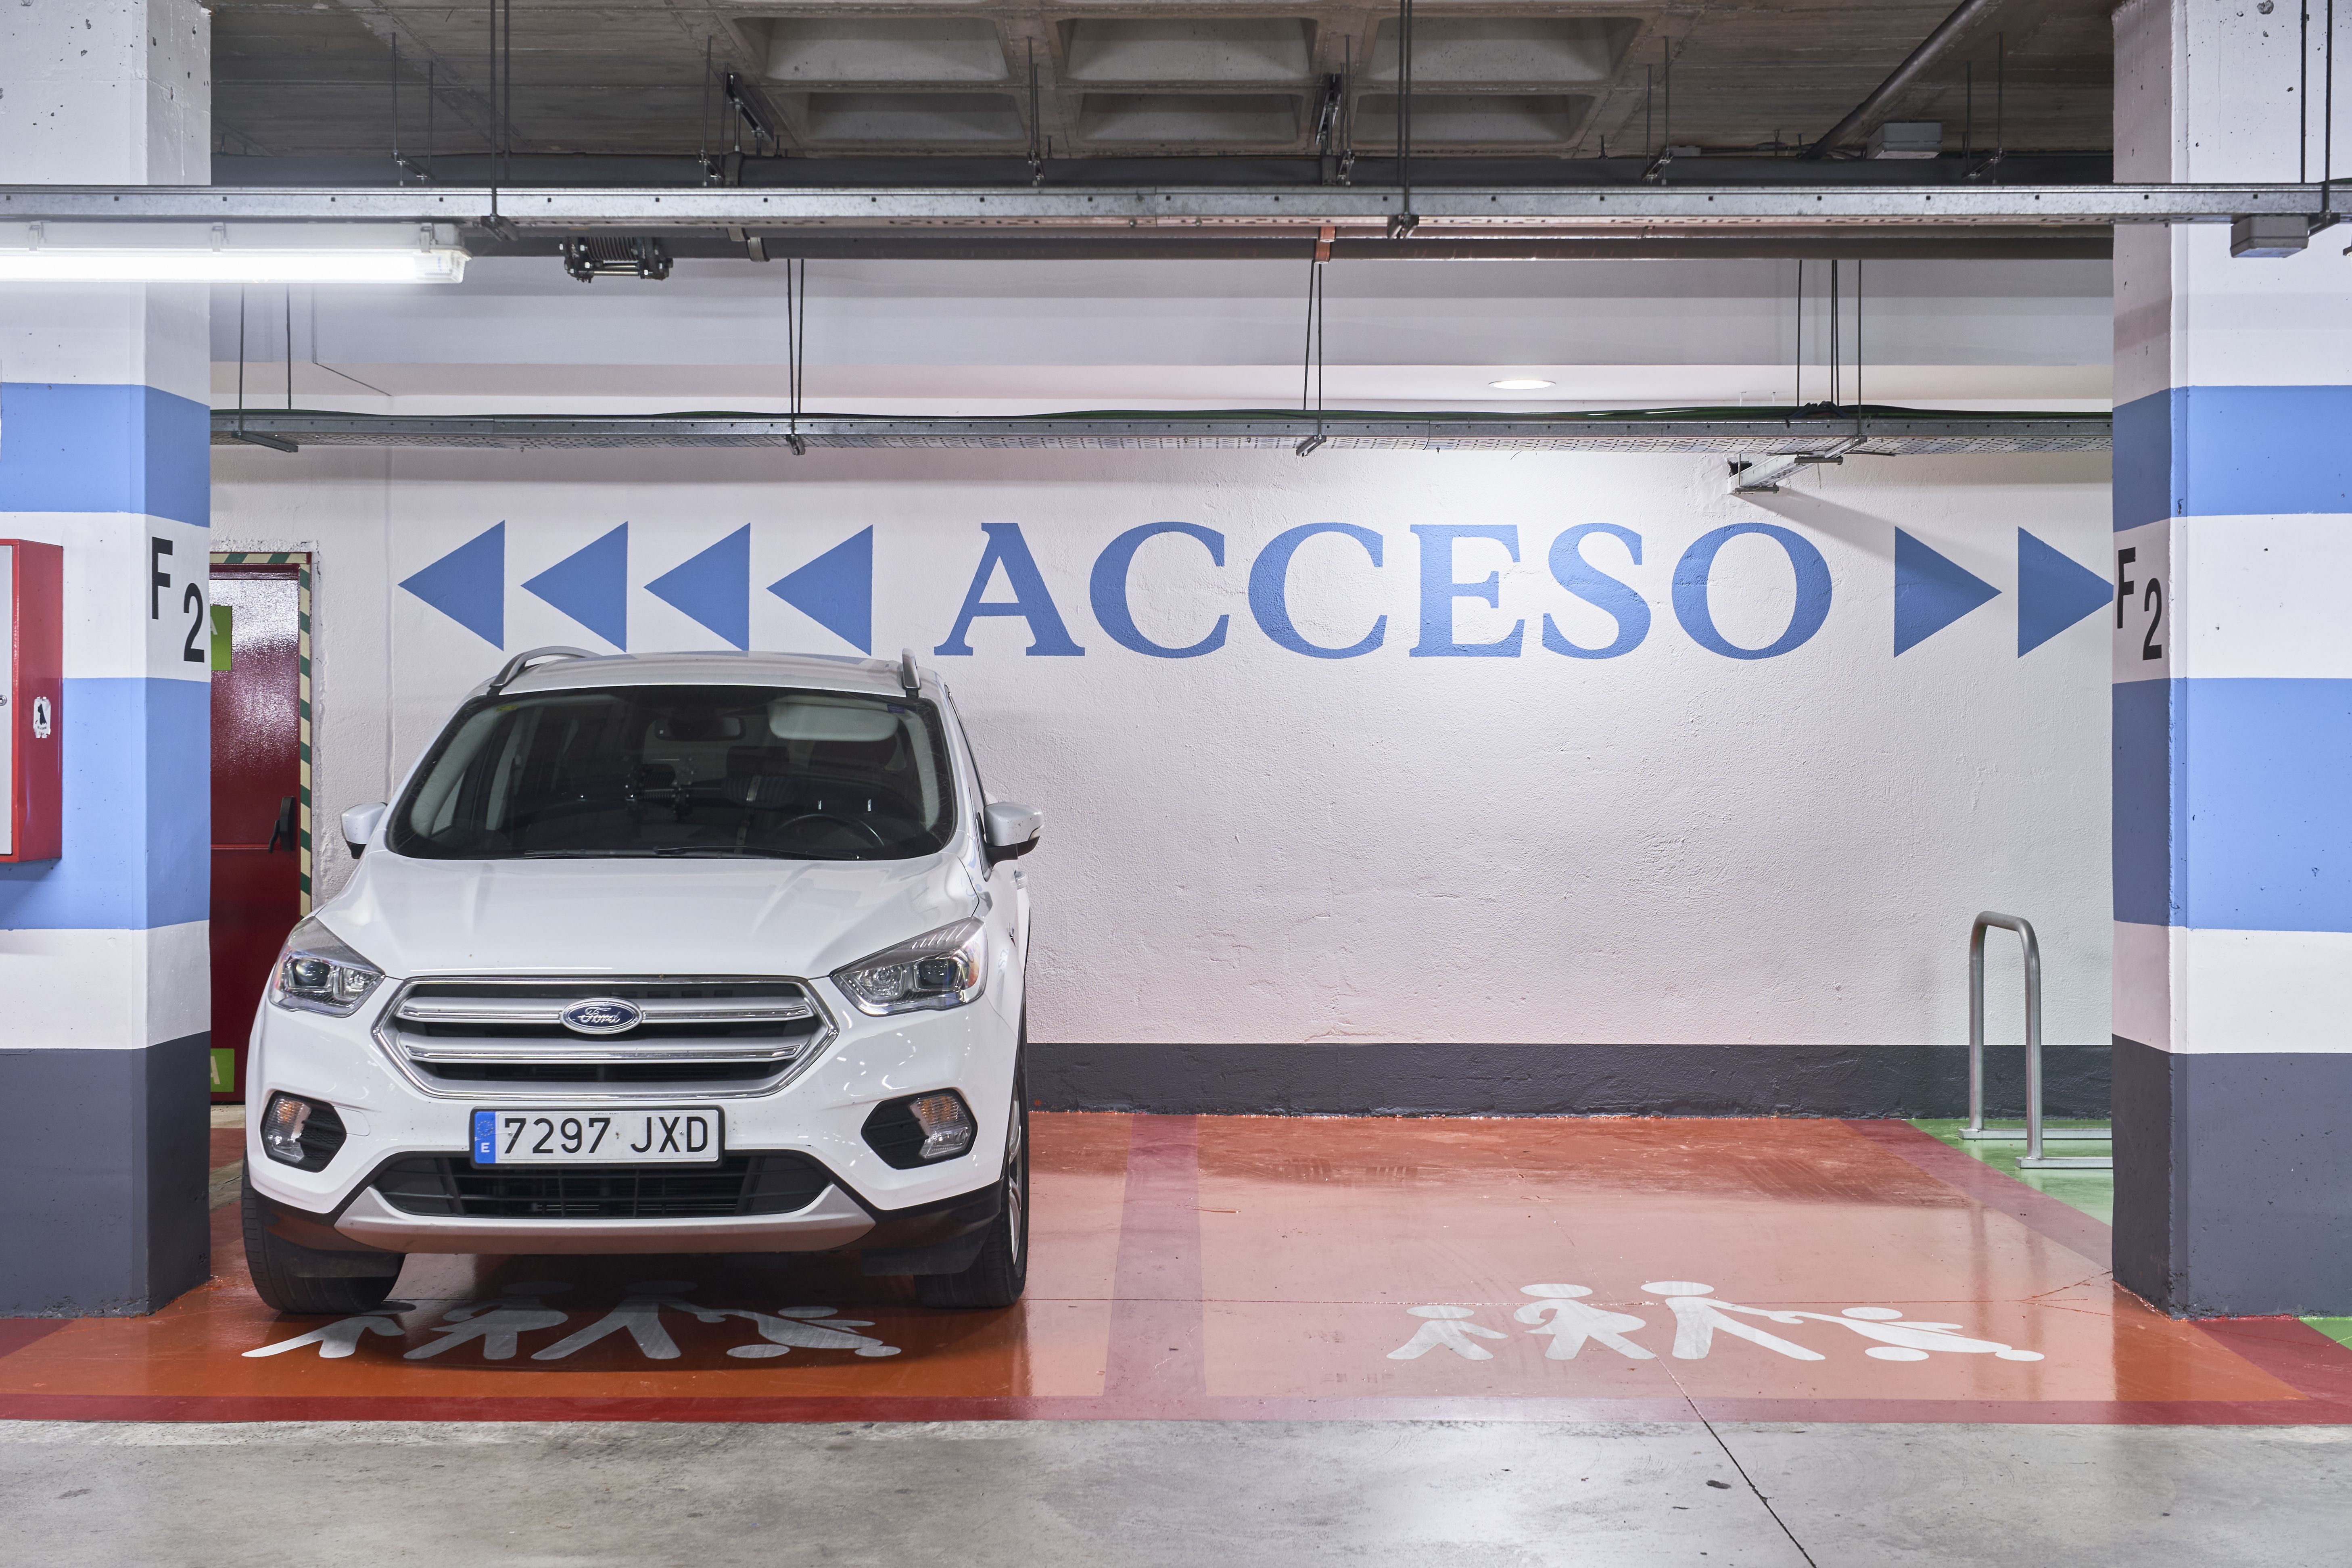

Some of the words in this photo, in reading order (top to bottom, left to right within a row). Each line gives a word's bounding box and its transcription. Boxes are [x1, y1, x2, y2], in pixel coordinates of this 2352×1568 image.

[934, 522, 1832, 660] ACCESO
[577, 1006, 622, 1023] Ford
[481, 1142, 490, 1153] E
[505, 1117, 611, 1154] 7297
[631, 1116, 708, 1153] JXD
